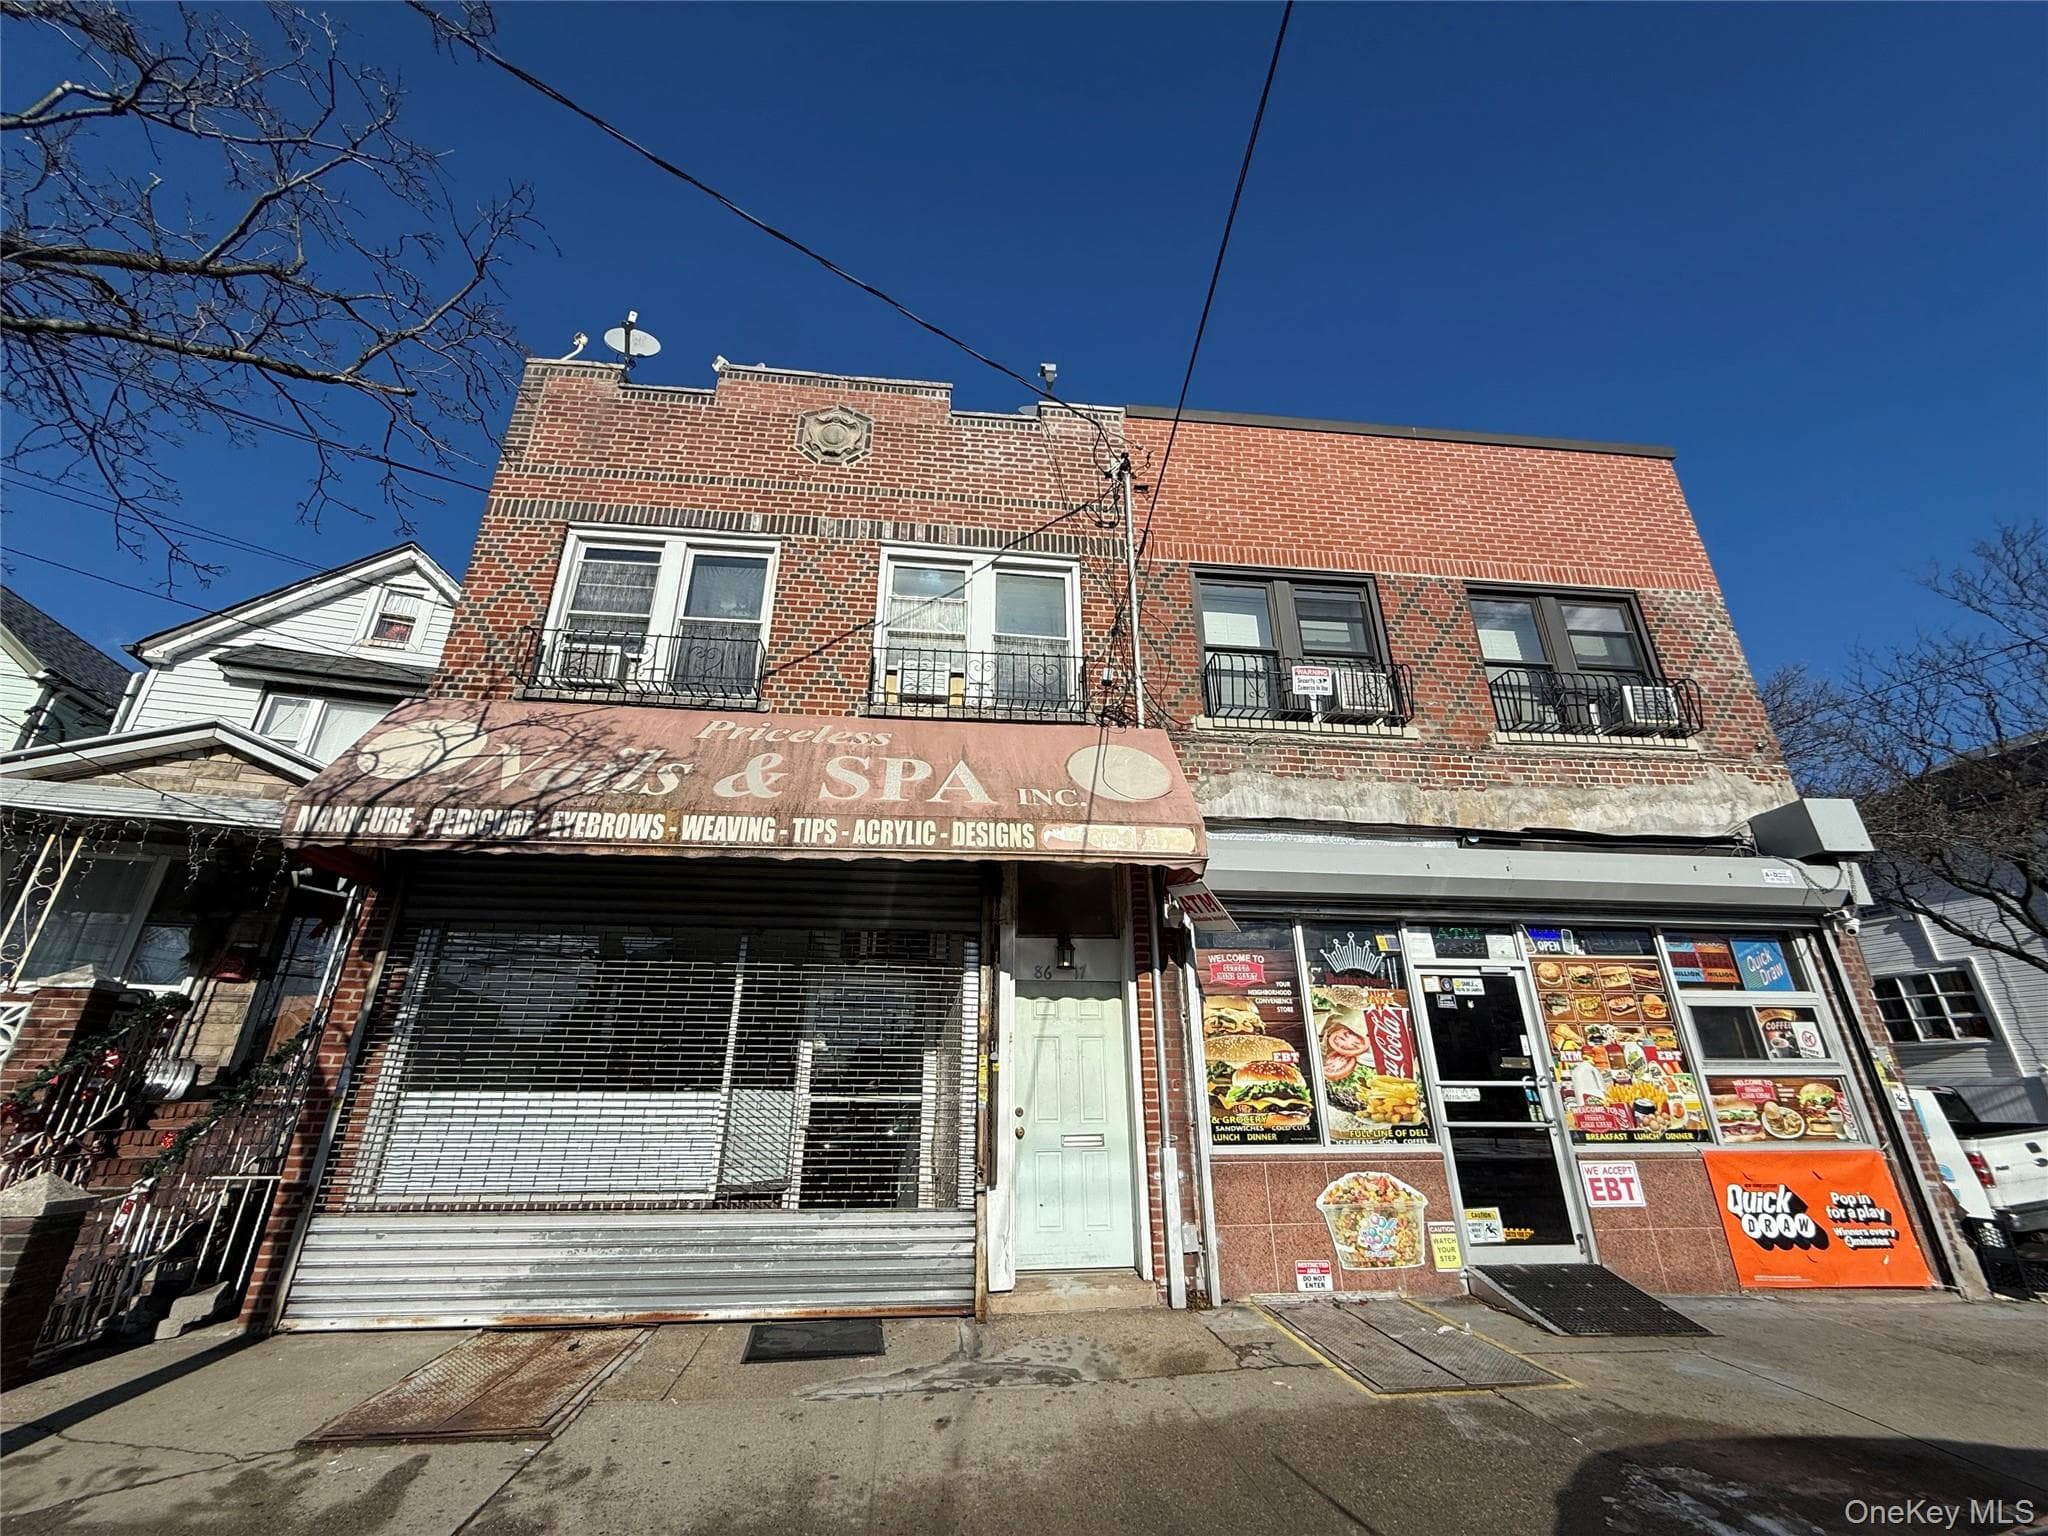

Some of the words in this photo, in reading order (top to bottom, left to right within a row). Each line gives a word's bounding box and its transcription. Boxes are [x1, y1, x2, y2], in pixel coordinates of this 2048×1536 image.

[697, 720, 893, 747] Priceless
[443, 741, 696, 799] Nails
[713, 752, 791, 800] &
[820, 756, 999, 804] SPA
[1017, 787, 1087, 808] INC.
[294, 805, 413, 834] MANICURE
[428, 808, 533, 837] PEDICURE
[549, 811, 666, 842] EYEBROWS
[681, 815, 776, 843] WEAVING
[793, 817, 837, 845] TIPS
[852, 820, 936, 847] ACRYLIC
[952, 821, 1035, 849] DESIGNS
[1179, 893, 1221, 913] ATM
[1436, 927, 1481, 940] ATM
[1537, 941, 1560, 952] OPEN
[1208, 954, 1251, 963] WELCOME
[1252, 954, 1265, 964] TO
[1747, 949, 1774, 972] Quick
[1034, 965, 1053, 980] 86
[1760, 962, 1783, 986] Draw
[1273, 1051, 1300, 1063] EBT
[1560, 1050, 1583, 1062] ATM
[1656, 1051, 1682, 1061] EBT
[1573, 1106, 1605, 1114] WELCOME
[1211, 1116, 1220, 1124] &
[1222, 1115, 1268, 1124] GROCERY
[1213, 1133, 1240, 1142] LUNCH
[1246, 1133, 1278, 1141] DINNER
[1351, 1129, 1370, 1137] FULL
[1373, 1129, 1393, 1137] LINE
[1395, 1129, 1407, 1137] OF
[1409, 1129, 1429, 1137] DELI
[1585, 1133, 1628, 1141] BREAKFAST
[1633, 1133, 1660, 1141] LUNCH
[1665, 1133, 1695, 1141] DINNER
[1584, 1166, 1599, 1175] WE
[1602, 1166, 1632, 1175] ACCEPT
[1588, 1177, 1635, 1201] EBT
[1728, 1184, 1792, 1216] Quick
[1830, 1191, 1857, 1206] Pop
[1858, 1191, 1871, 1204] in
[1470, 1211, 1492, 1219] CAUTION
[1826, 1205, 1848, 1220] for
[1849, 1208, 1858, 1219] a
[1858, 1206, 1886, 1221] play
[1746, 1218, 1811, 1235] DRAW
[1834, 1227, 1868, 1237] Winners
[1869, 1228, 1896, 1238] every
[1853, 1237, 1892, 1247] minutes
